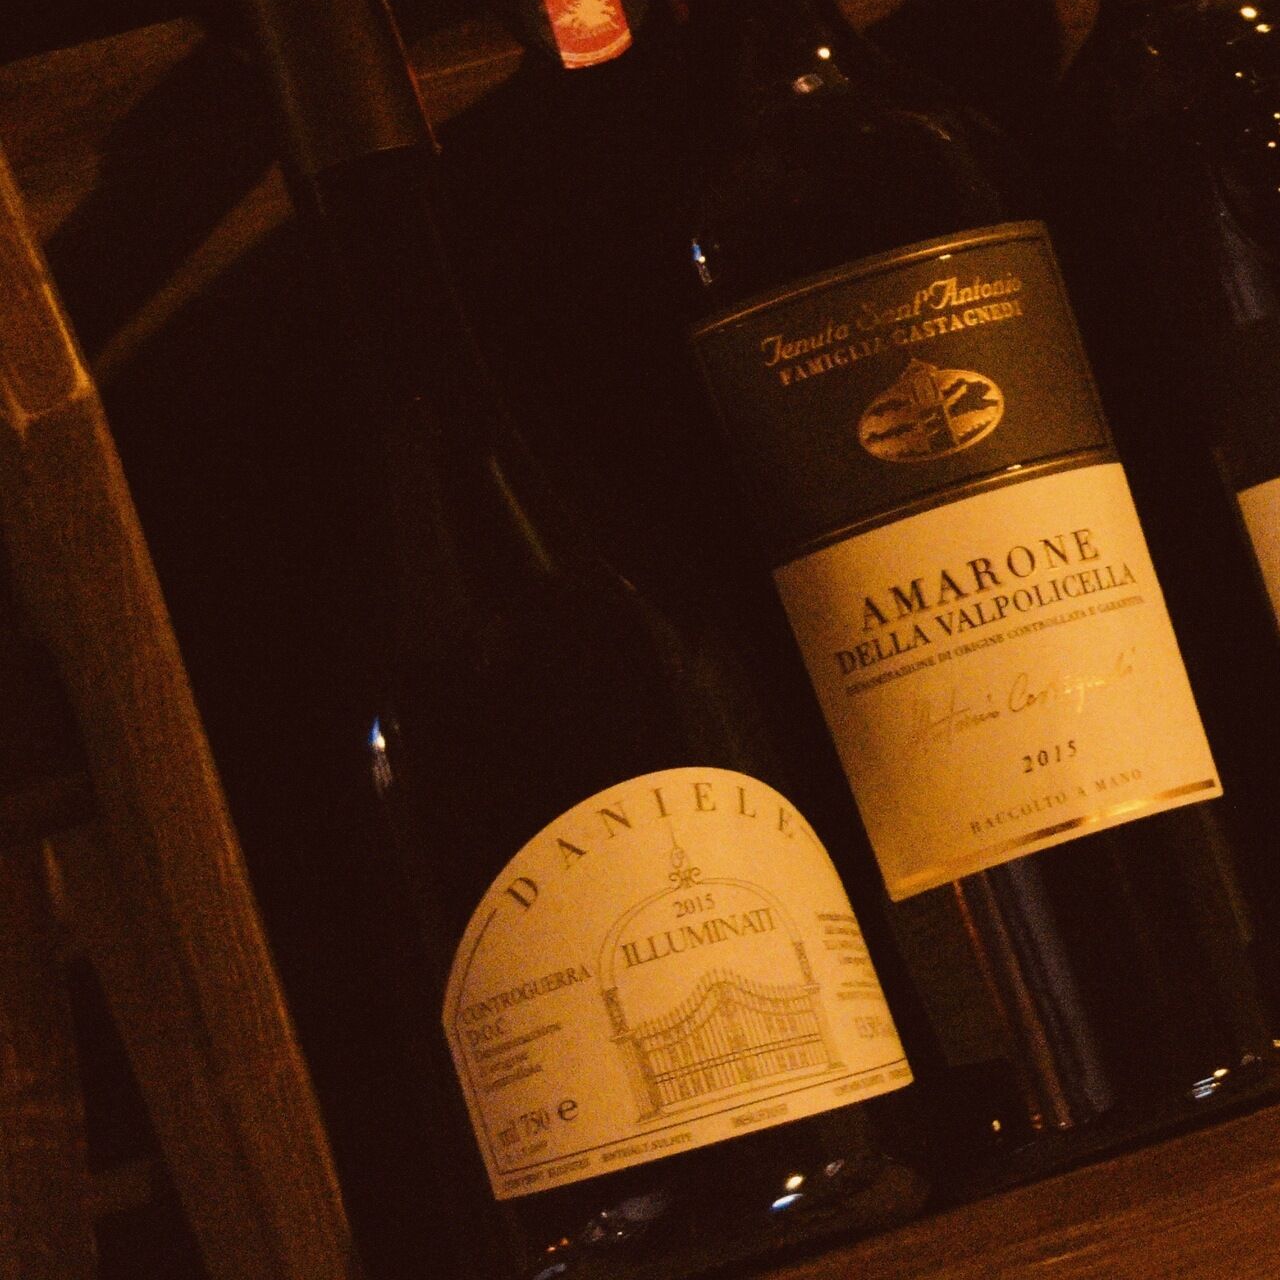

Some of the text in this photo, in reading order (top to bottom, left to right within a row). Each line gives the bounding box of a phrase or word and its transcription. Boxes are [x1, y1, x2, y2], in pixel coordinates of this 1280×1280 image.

[894, 297, 1026, 345] CASTAGNEDI
[860, 527, 1101, 633] AMARONE
[834, 561, 1138, 677] DELLA VALPOLICELLA
[953, 634, 1007, 660] ORIGINE
[1021, 739, 1080, 775] 2015
[969, 767, 1144, 836] RACCOLTO A MANO
[505, 780, 798, 912] DANIELE
[672, 892, 715, 919] 2015
[620, 907, 778, 969] ILLUMINATI
